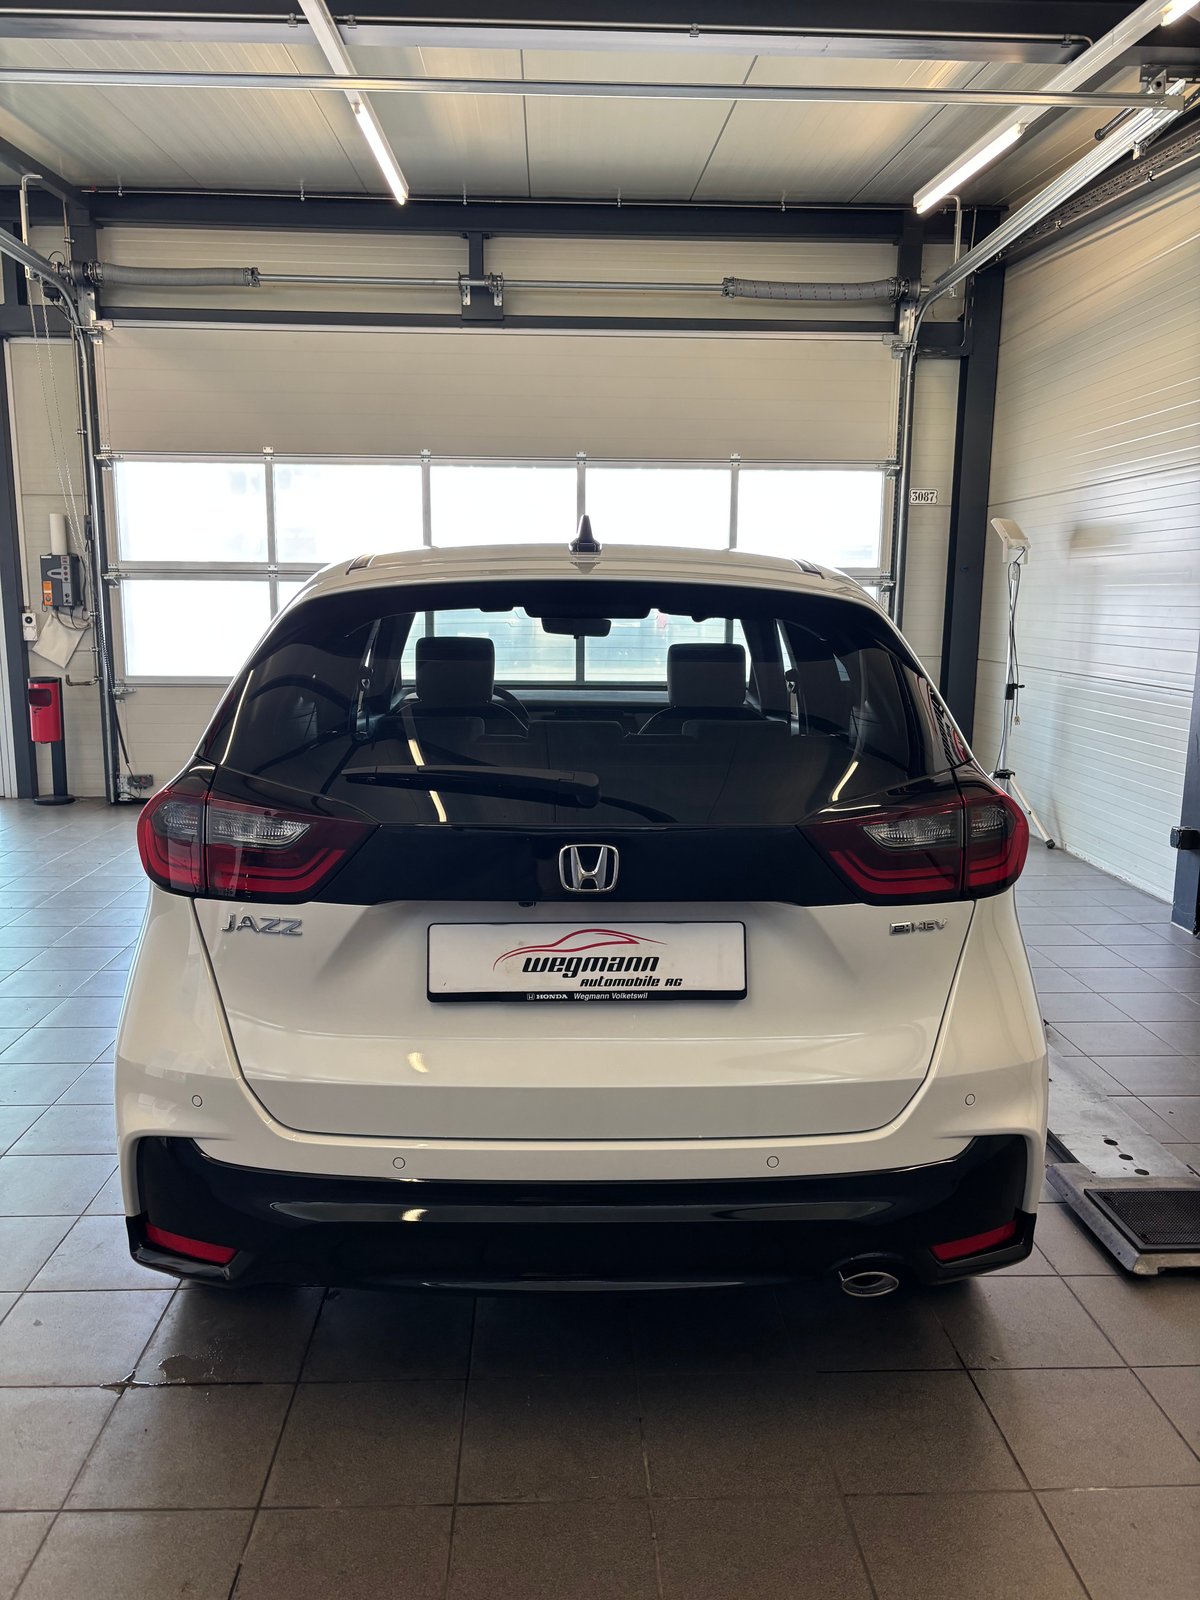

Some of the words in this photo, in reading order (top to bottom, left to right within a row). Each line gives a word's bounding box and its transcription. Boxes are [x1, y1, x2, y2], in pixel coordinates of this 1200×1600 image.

[911, 491, 936, 502] 3087
[220, 913, 303, 936] JAZZ
[522, 956, 660, 978] wegmann
[664, 978, 683, 987] AG
[573, 992, 610, 1001] Wegmann
[611, 992, 649, 1000] Volketswil
